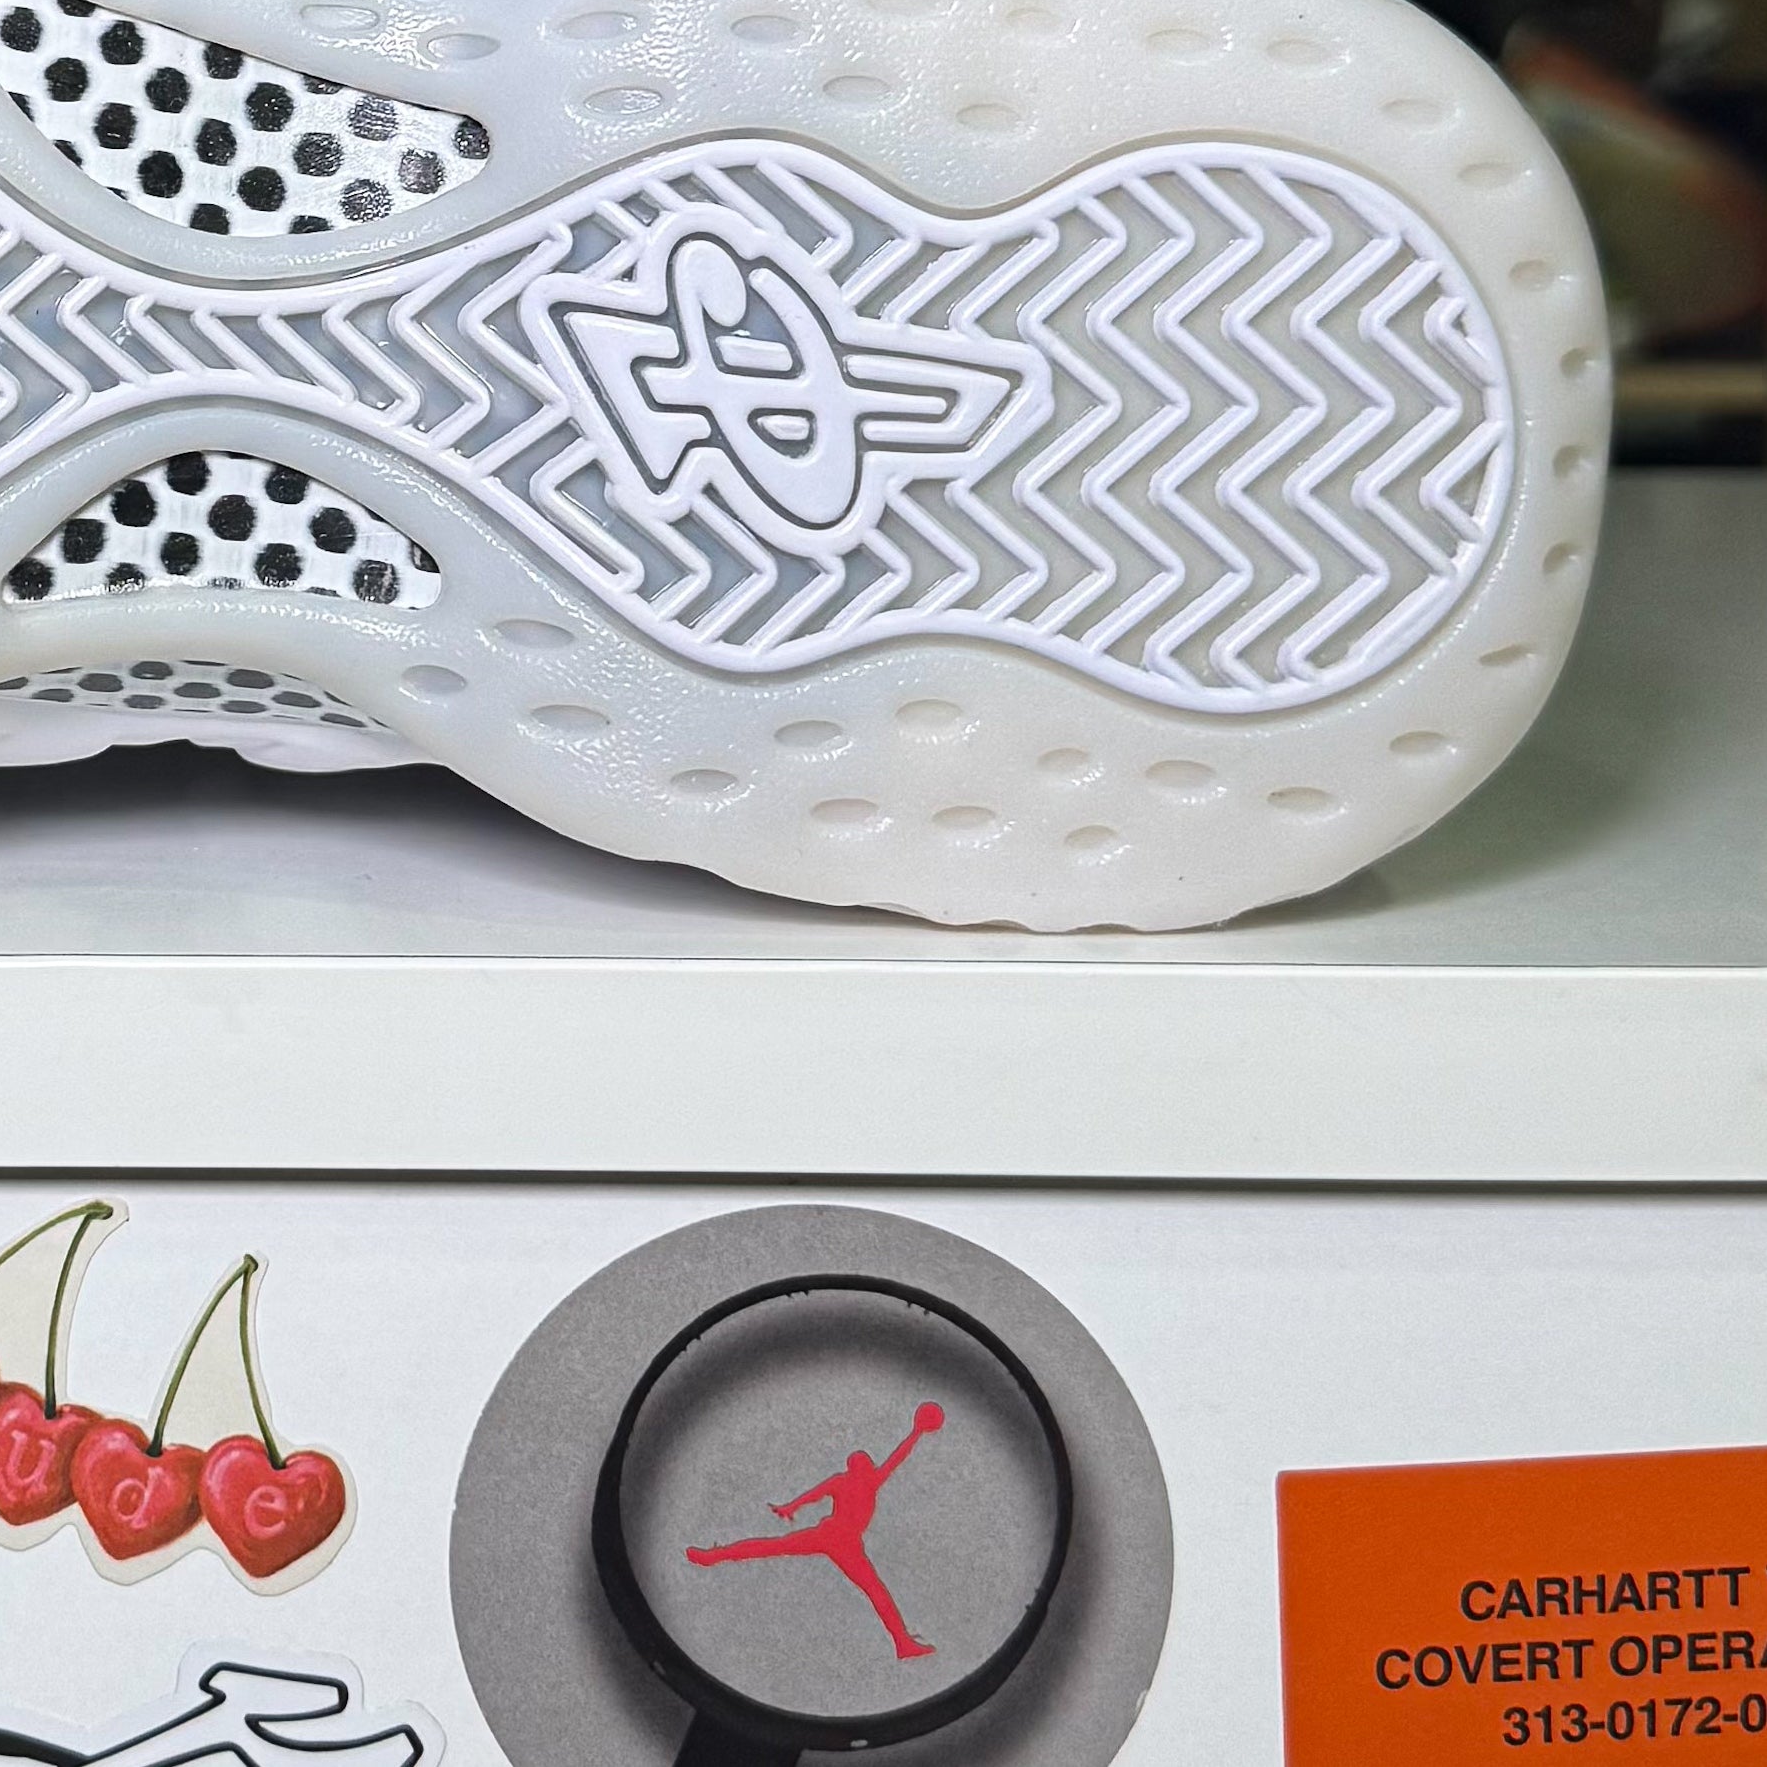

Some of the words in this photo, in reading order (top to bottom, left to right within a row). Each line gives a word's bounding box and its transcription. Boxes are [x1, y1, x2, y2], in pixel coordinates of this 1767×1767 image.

[1460, 1566, 1751, 1622] CARHARTT
[1375, 1639, 1594, 1690] COVERT
[1609, 1630, 1767, 1677] OPER
[1502, 1693, 1767, 1746] 313-0172-0
